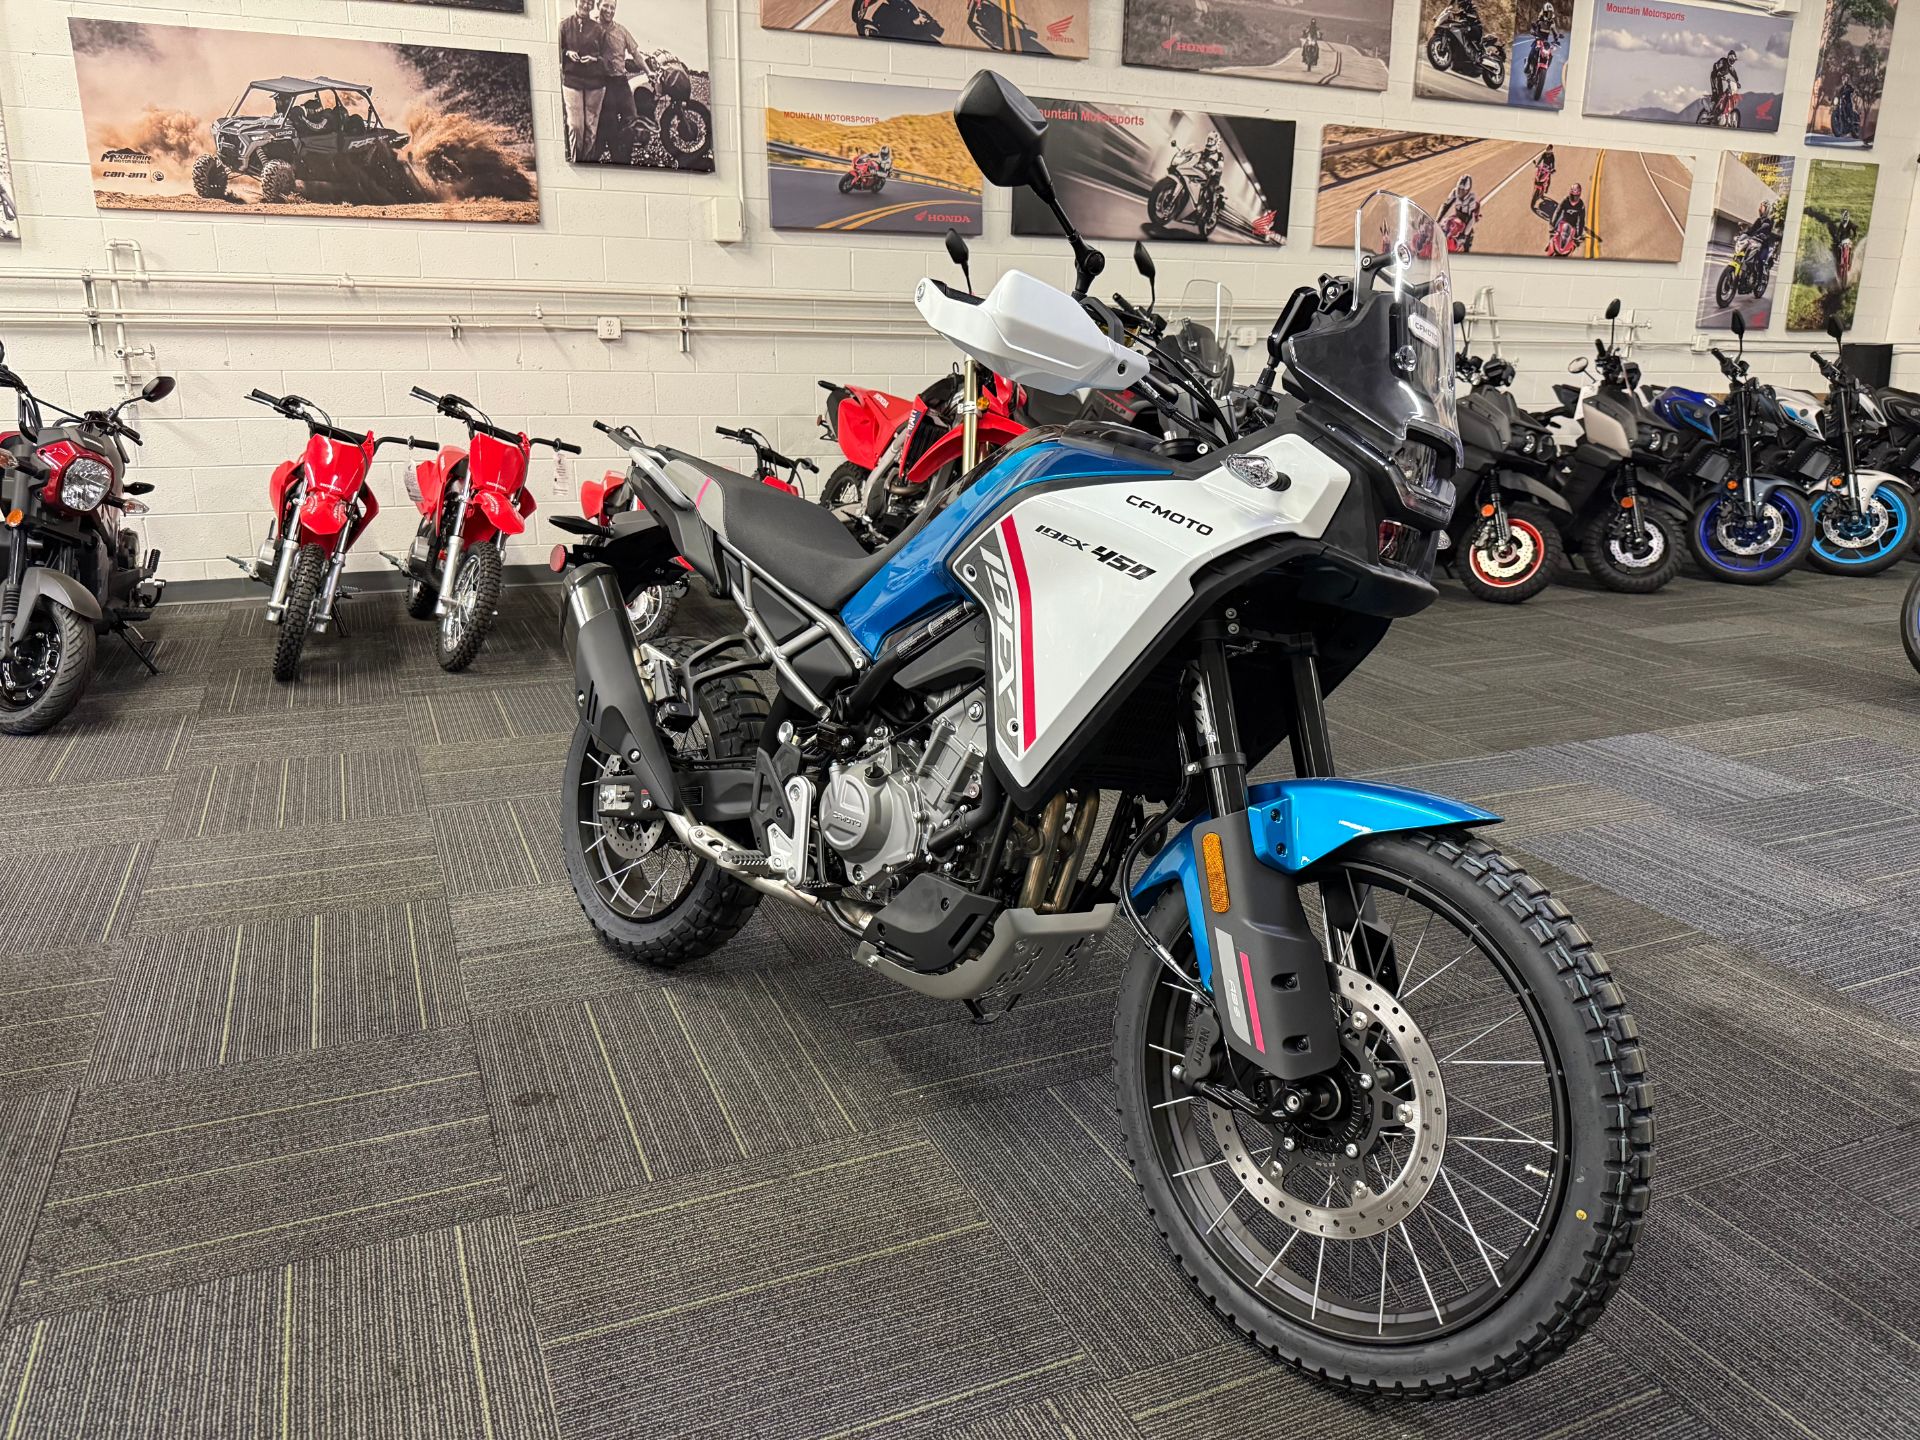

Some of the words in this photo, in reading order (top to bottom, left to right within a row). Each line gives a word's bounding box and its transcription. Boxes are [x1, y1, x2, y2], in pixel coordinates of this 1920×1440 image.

[1606, 3, 1640, 15] Mountain
[1642, 7, 1685, 20] Motorsports
[783, 111, 822, 121] MOUNTAIN
[824, 114, 880, 124] MOTORSPORTS
[1081, 111, 1144, 125] Motorsports
[928, 214, 972, 223] HONDA
[1125, 495, 1214, 536] CFMOTO
[1035, 524, 1091, 551] IBEX
[1091, 545, 1157, 581] 450
[979, 546, 1016, 712] IBEX
